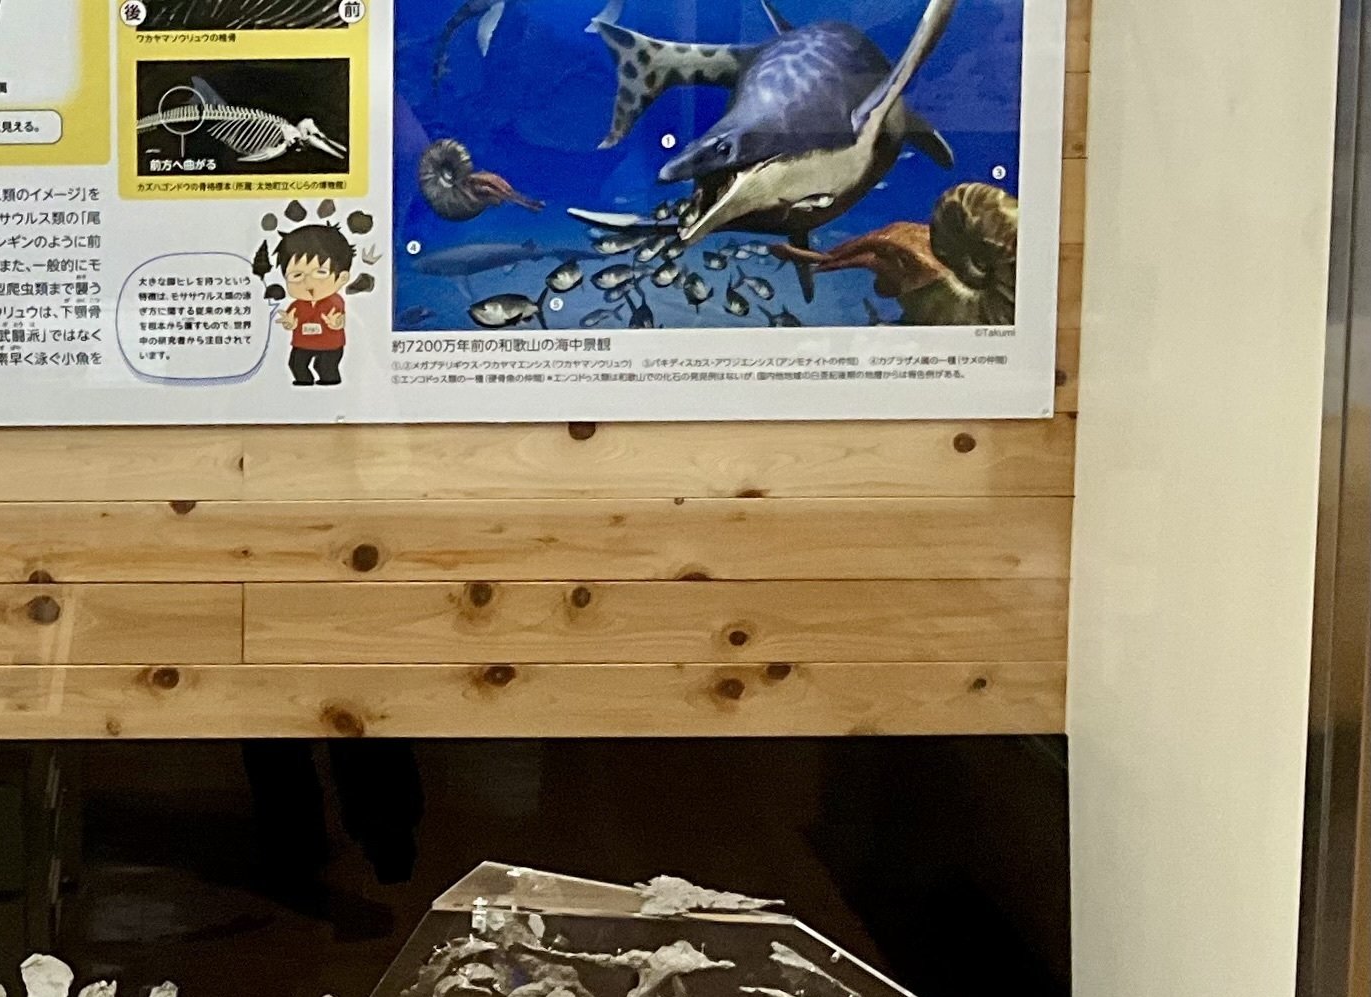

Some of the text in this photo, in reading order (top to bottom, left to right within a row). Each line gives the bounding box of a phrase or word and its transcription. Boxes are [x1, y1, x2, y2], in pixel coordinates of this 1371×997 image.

[125, 4, 141, 20] 後
[150, 158, 216, 171] 前方へ曲がる
[392, 336, 611, 353] 約7200万年前の和歌山の海中景観
